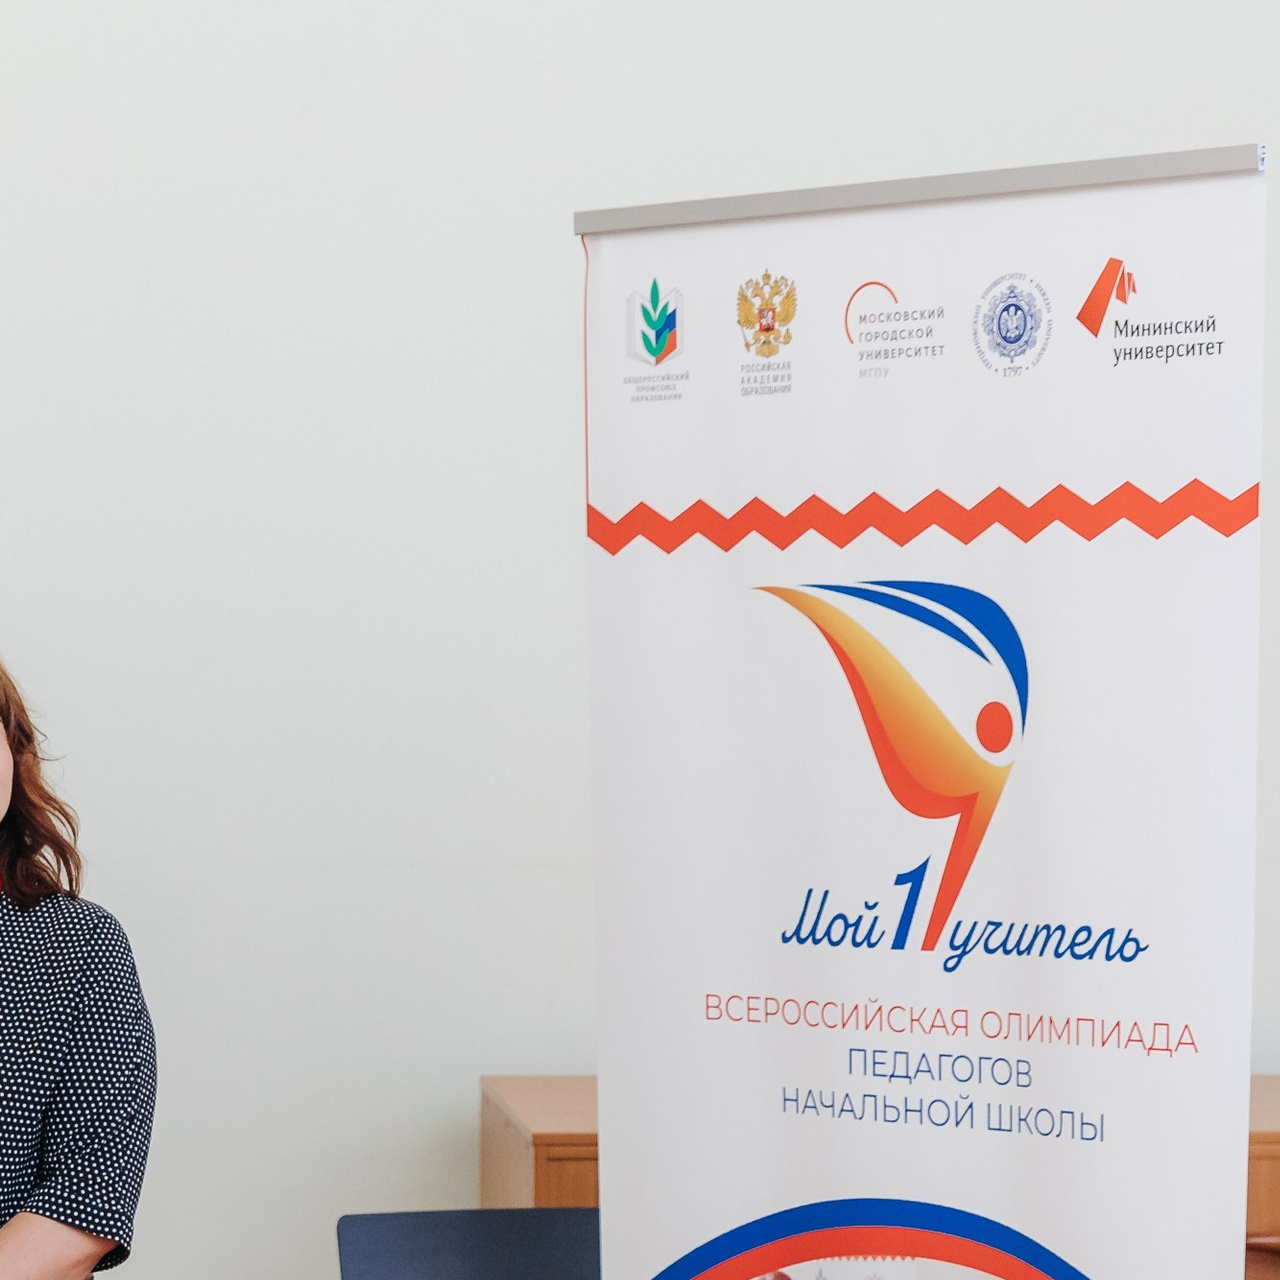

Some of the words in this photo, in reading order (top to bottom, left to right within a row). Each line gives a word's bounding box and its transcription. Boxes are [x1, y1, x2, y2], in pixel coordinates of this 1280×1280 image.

[858, 306, 945, 324] МОСКОВСКИЙ
[1113, 315, 1216, 339] Мининский
[858, 325, 934, 343] ГОРОДСКОЙ
[858, 345, 945, 362] УНИВЕРСИТЕТ
[1113, 341, 1225, 367] университет
[740, 361, 792, 373] РОССИЙСКАЯ
[858, 366, 890, 379] МГПУ
[781, 888, 886, 950] Мой
[942, 918, 1149, 973] учитель
[705, 993, 970, 1038] ВСЕРОССИЙСКАЯ
[980, 1010, 1199, 1058] ОЛИМПИАДА
[848, 1048, 1033, 1089] ПЕДАГОГОВ
[782, 1086, 975, 1130] НАЧАЛЬНОЙ
[986, 1102, 1105, 1142] ШКОЛЫ
